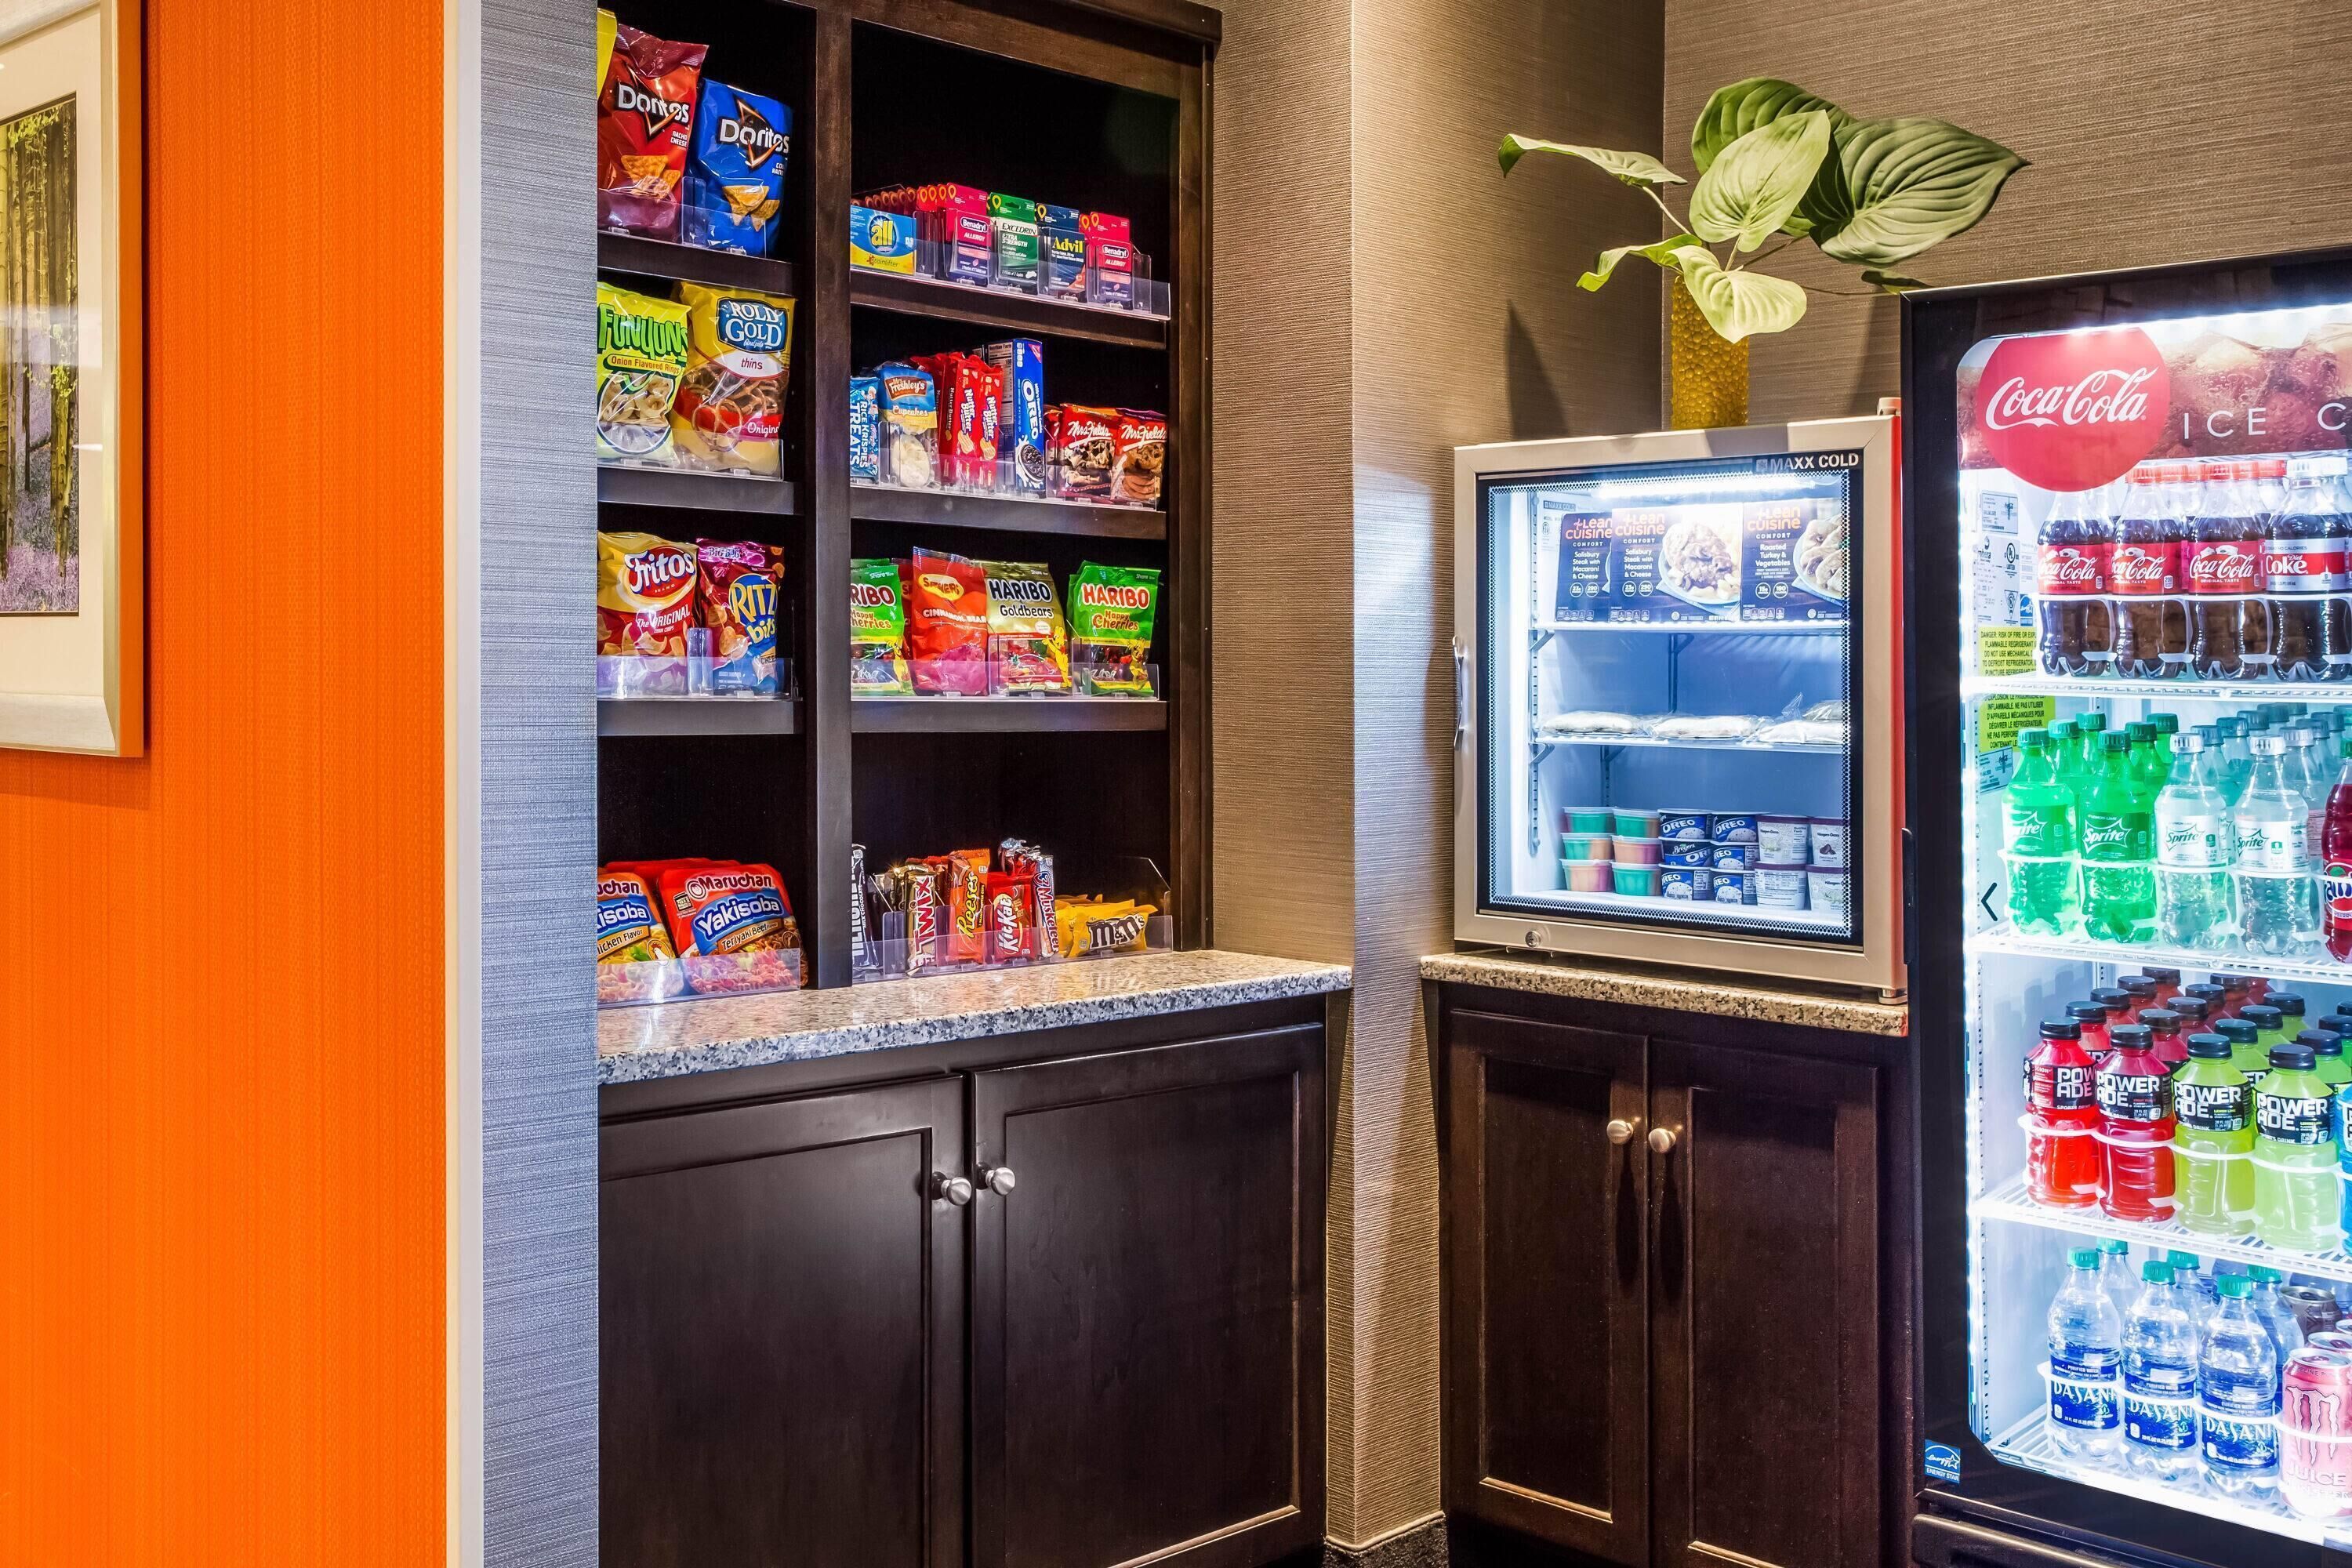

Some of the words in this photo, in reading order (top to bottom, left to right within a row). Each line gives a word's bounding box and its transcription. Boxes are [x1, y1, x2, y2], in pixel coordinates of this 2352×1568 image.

[618, 85, 690, 124] Doritos
[719, 118, 790, 154] Doritos
[871, 220, 894, 247] all
[963, 219, 986, 232] Benadryl
[1001, 222, 1037, 236] EXCEDRIN
[964, 232, 985, 241] ALLERGY
[1052, 237, 1083, 253] Advil
[1103, 245, 1127, 258] Benadryl
[1105, 259, 1127, 267] ALLERGY
[728, 300, 784, 322] ROLD
[725, 318, 782, 347] GOLD
[611, 356, 633, 366] Onion
[634, 359, 663, 372] Flavored
[664, 363, 680, 374] Rings
[741, 357, 763, 370] thins
[889, 380, 925, 394] Freshley's
[1984, 366, 2159, 430] Coca-Cola
[892, 405, 929, 417] Cupcakes
[1022, 379, 1039, 440] OREO
[2183, 407, 2267, 440] ICE
[850, 402, 862, 466] TREATS
[861, 424, 869, 468] KRISPIES
[1769, 456, 1815, 471] MAXX
[1818, 452, 1860, 469] COLD
[1582, 517, 1613, 529] Lean
[1632, 514, 1665, 525] Lean
[1759, 543, 1787, 551] Roasted
[1759, 551, 1781, 560] Turkey
[624, 548, 696, 594] Fritos
[1755, 560, 1791, 568] Vegetables
[2189, 554, 2256, 579] Coca-Cola
[2265, 555, 2307, 575] Coke
[989, 580, 1051, 601] HARIBO
[1082, 584, 1149, 608] HARIBO
[730, 583, 778, 623] RITZ
[1000, 604, 1053, 618] Goldbears
[651, 603, 691, 628] ORIGINAL
[1092, 614, 1139, 631] Cherries
[1105, 610, 1130, 622] Happy
[746, 619, 775, 644] bits
[1990, 739, 2012, 749] CONTENANT
[1661, 818, 1696, 833] OREO
[1715, 818, 1746, 834] OREO
[2085, 828, 2125, 844] Sprite
[2167, 830, 2200, 844] Sprite
[2237, 837, 2264, 850] Sprite
[1671, 843, 1697, 855] Breyers
[699, 873, 773, 891] Maruchan
[956, 871, 979, 938] Reese's
[697, 896, 780, 937] Yakisoba
[913, 876, 935, 952] TWIX
[623, 929, 644, 942] Flavor
[721, 929, 752, 951] Teriyaki
[752, 924, 768, 936] Beef
[2096, 1070, 2160, 1094] POWER
[2173, 1081, 2242, 1105] POWER
[2256, 1092, 2328, 1116] POWER
[1926, 1467, 1946, 1477] ENERGY
[2283, 1462, 2347, 1486] JUICE
